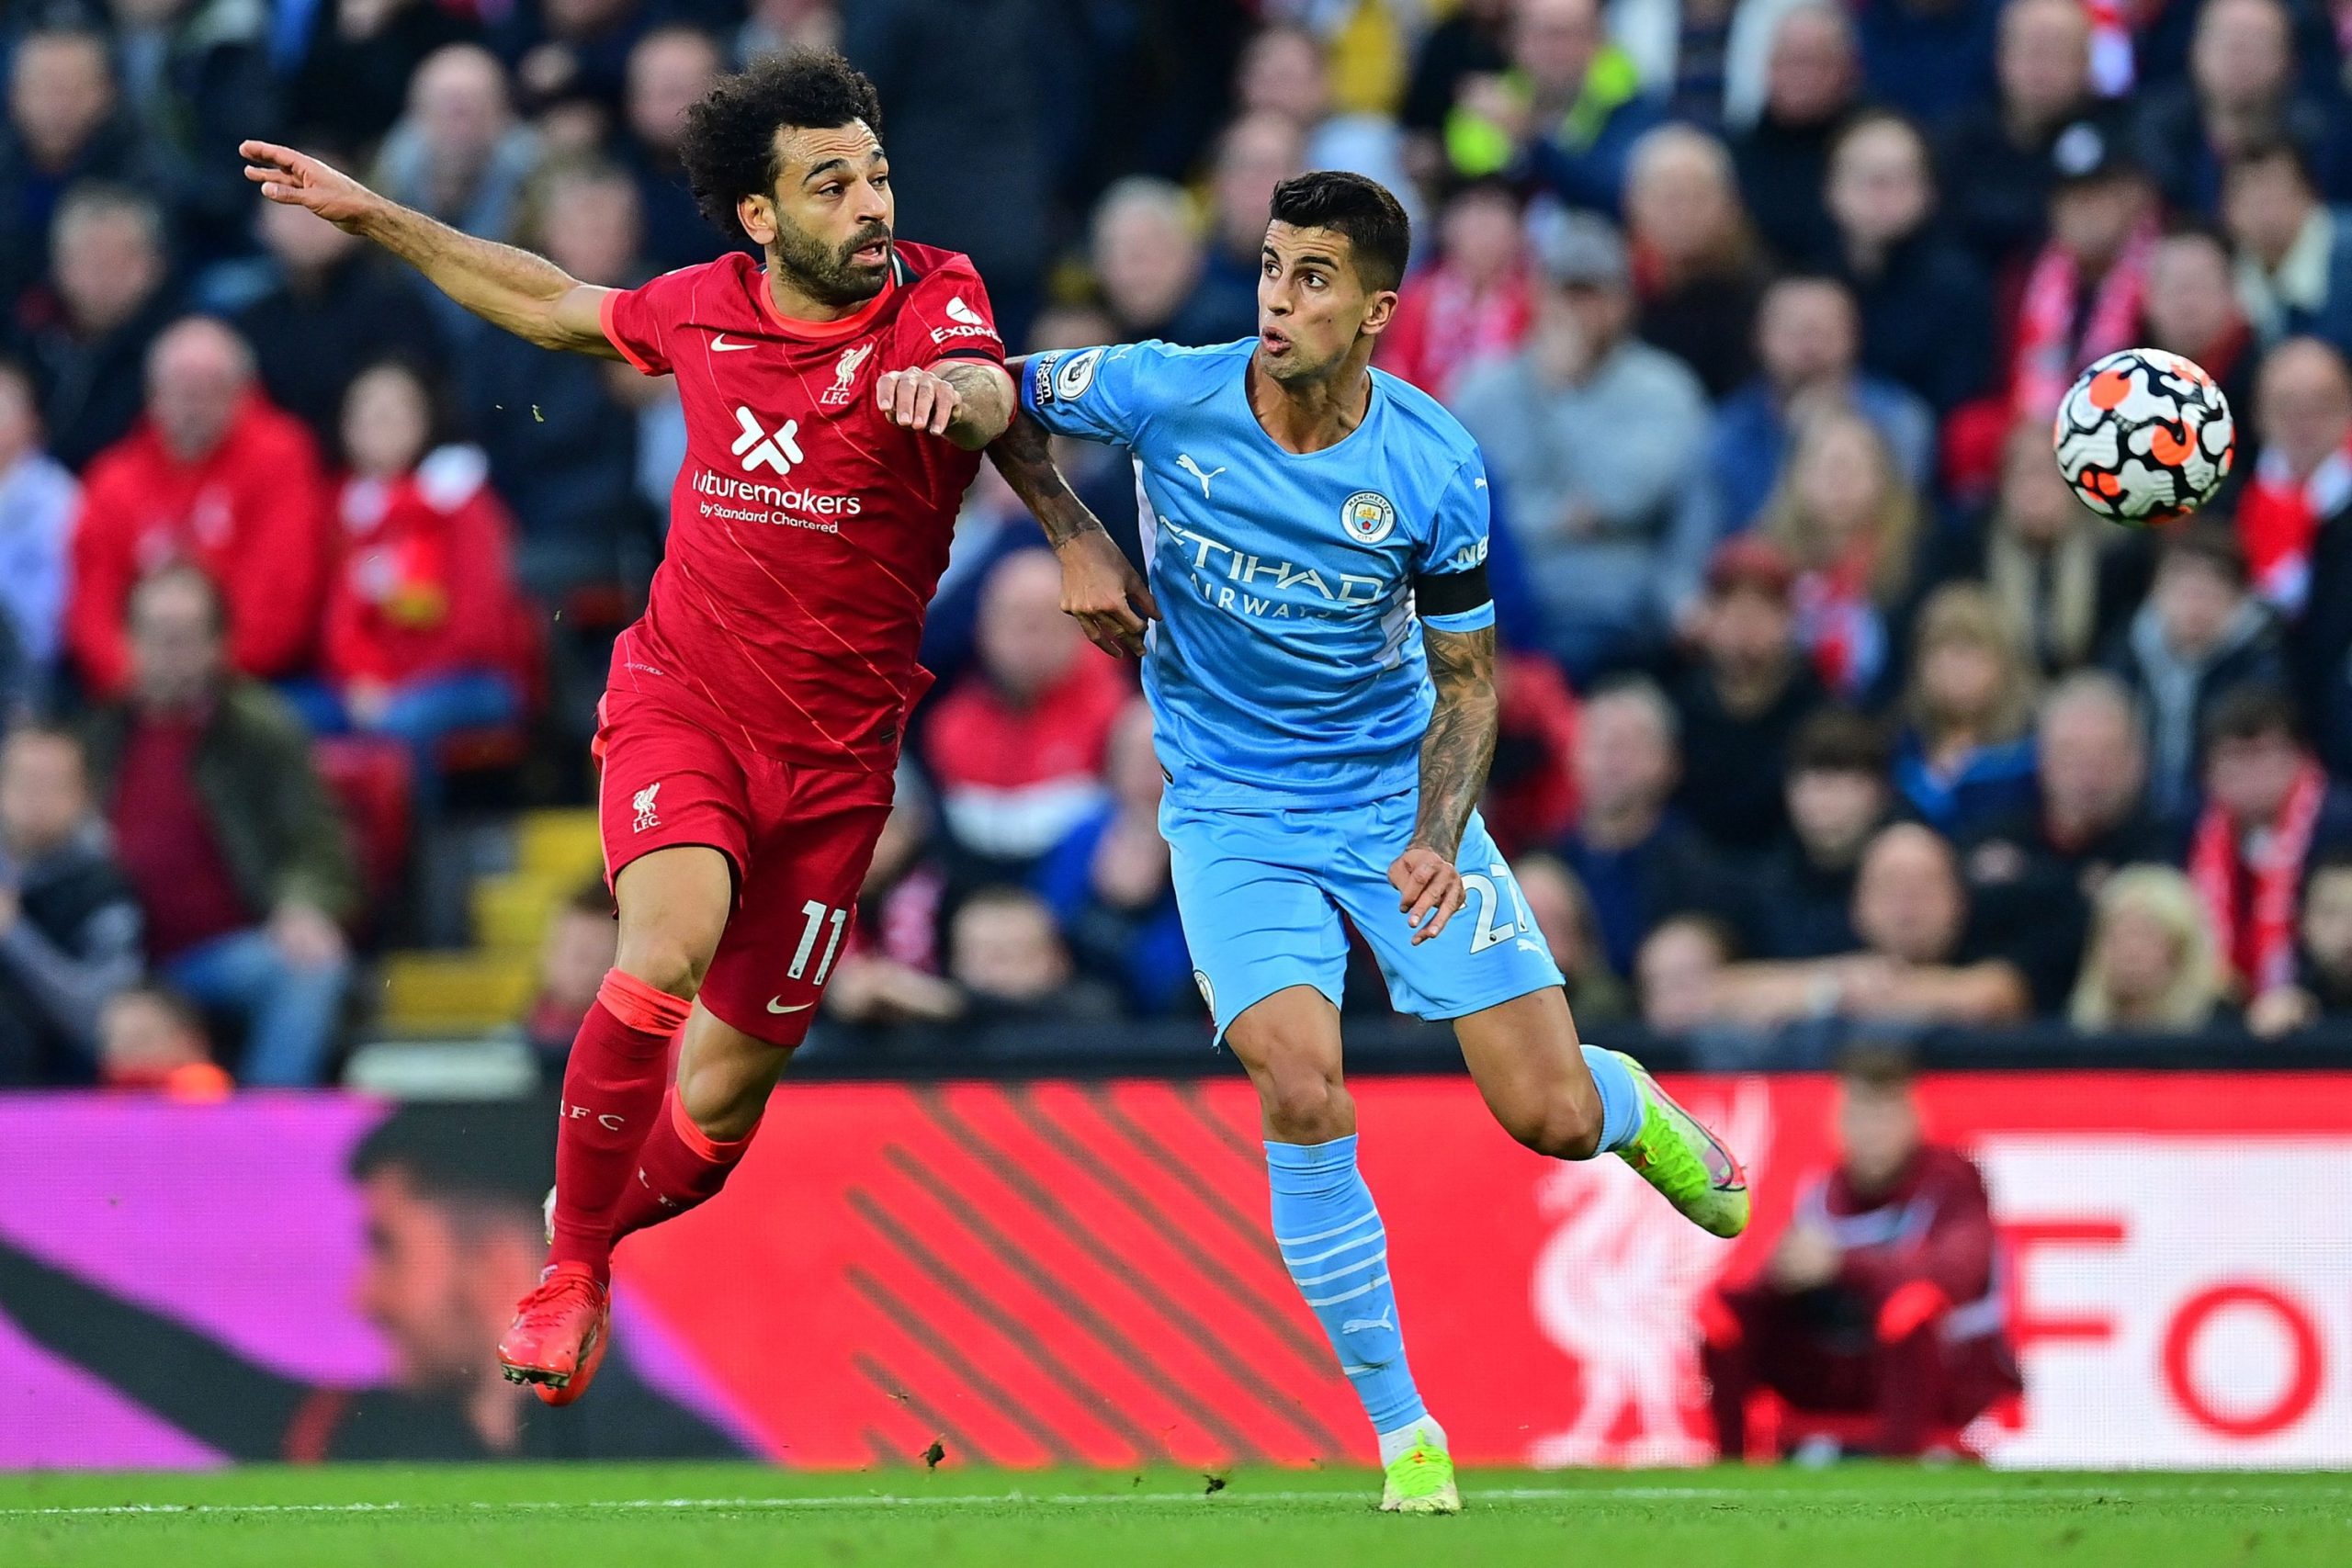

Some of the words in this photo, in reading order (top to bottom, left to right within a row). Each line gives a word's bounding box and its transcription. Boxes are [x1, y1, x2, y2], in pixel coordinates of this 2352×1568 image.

[1348, 494, 1392, 514] MANCHESTER
[699, 502, 713, 518] by
[713, 503, 768, 524] Standard
[771, 512, 839, 535] Chartered
[1357, 534, 1373, 542] CITY
[787, 900, 847, 986] 11
